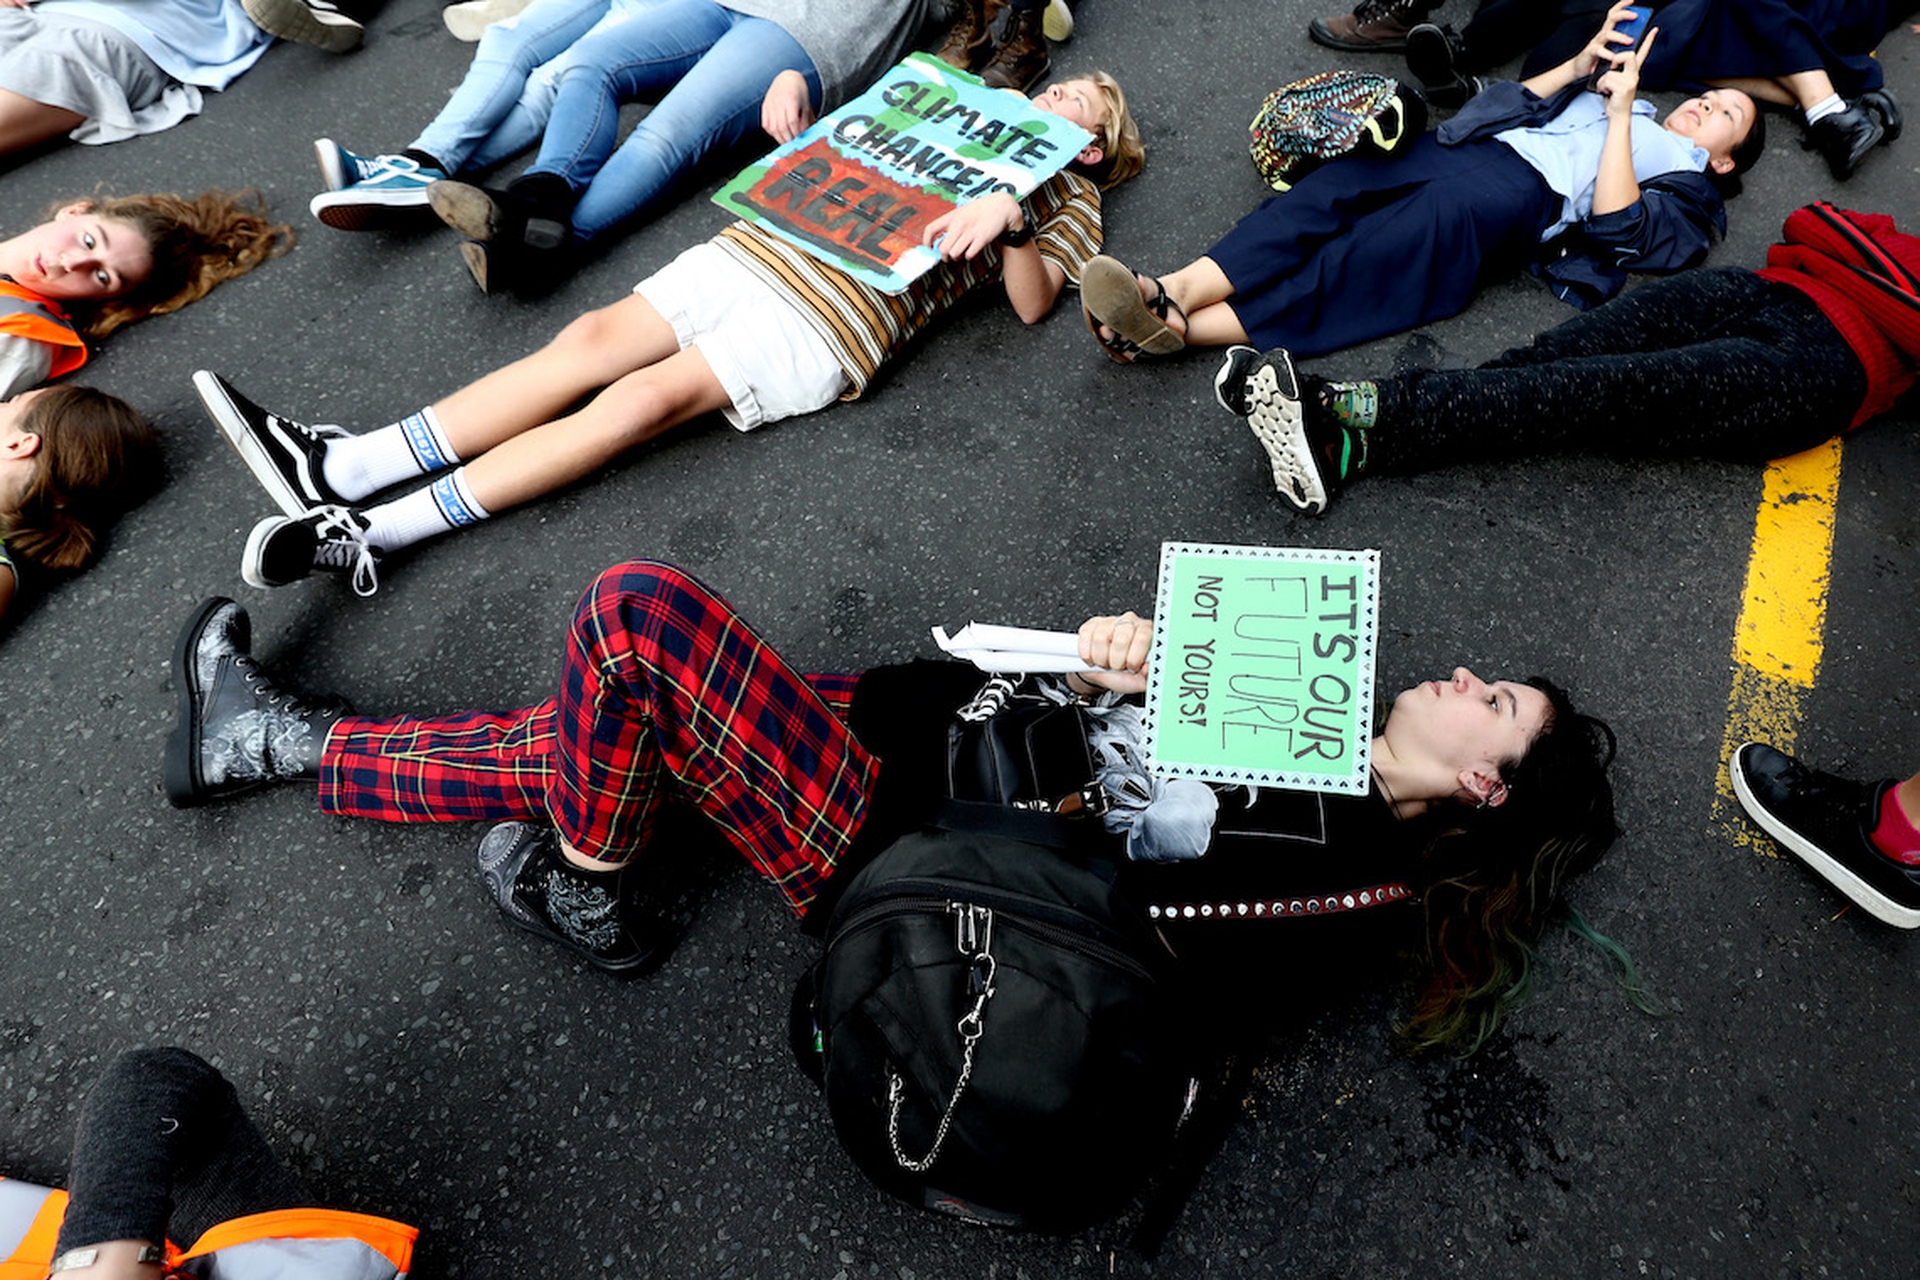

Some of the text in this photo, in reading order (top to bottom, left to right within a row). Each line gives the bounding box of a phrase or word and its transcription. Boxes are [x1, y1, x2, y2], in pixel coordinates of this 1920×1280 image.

[882, 80, 1059, 169] CLIMATE
[763, 157, 918, 261] REAL
[1178, 575, 1224, 728] NOT YOURS!
[1222, 576, 1308, 753] FUTURE
[1294, 575, 1358, 760] IT'S OUR
